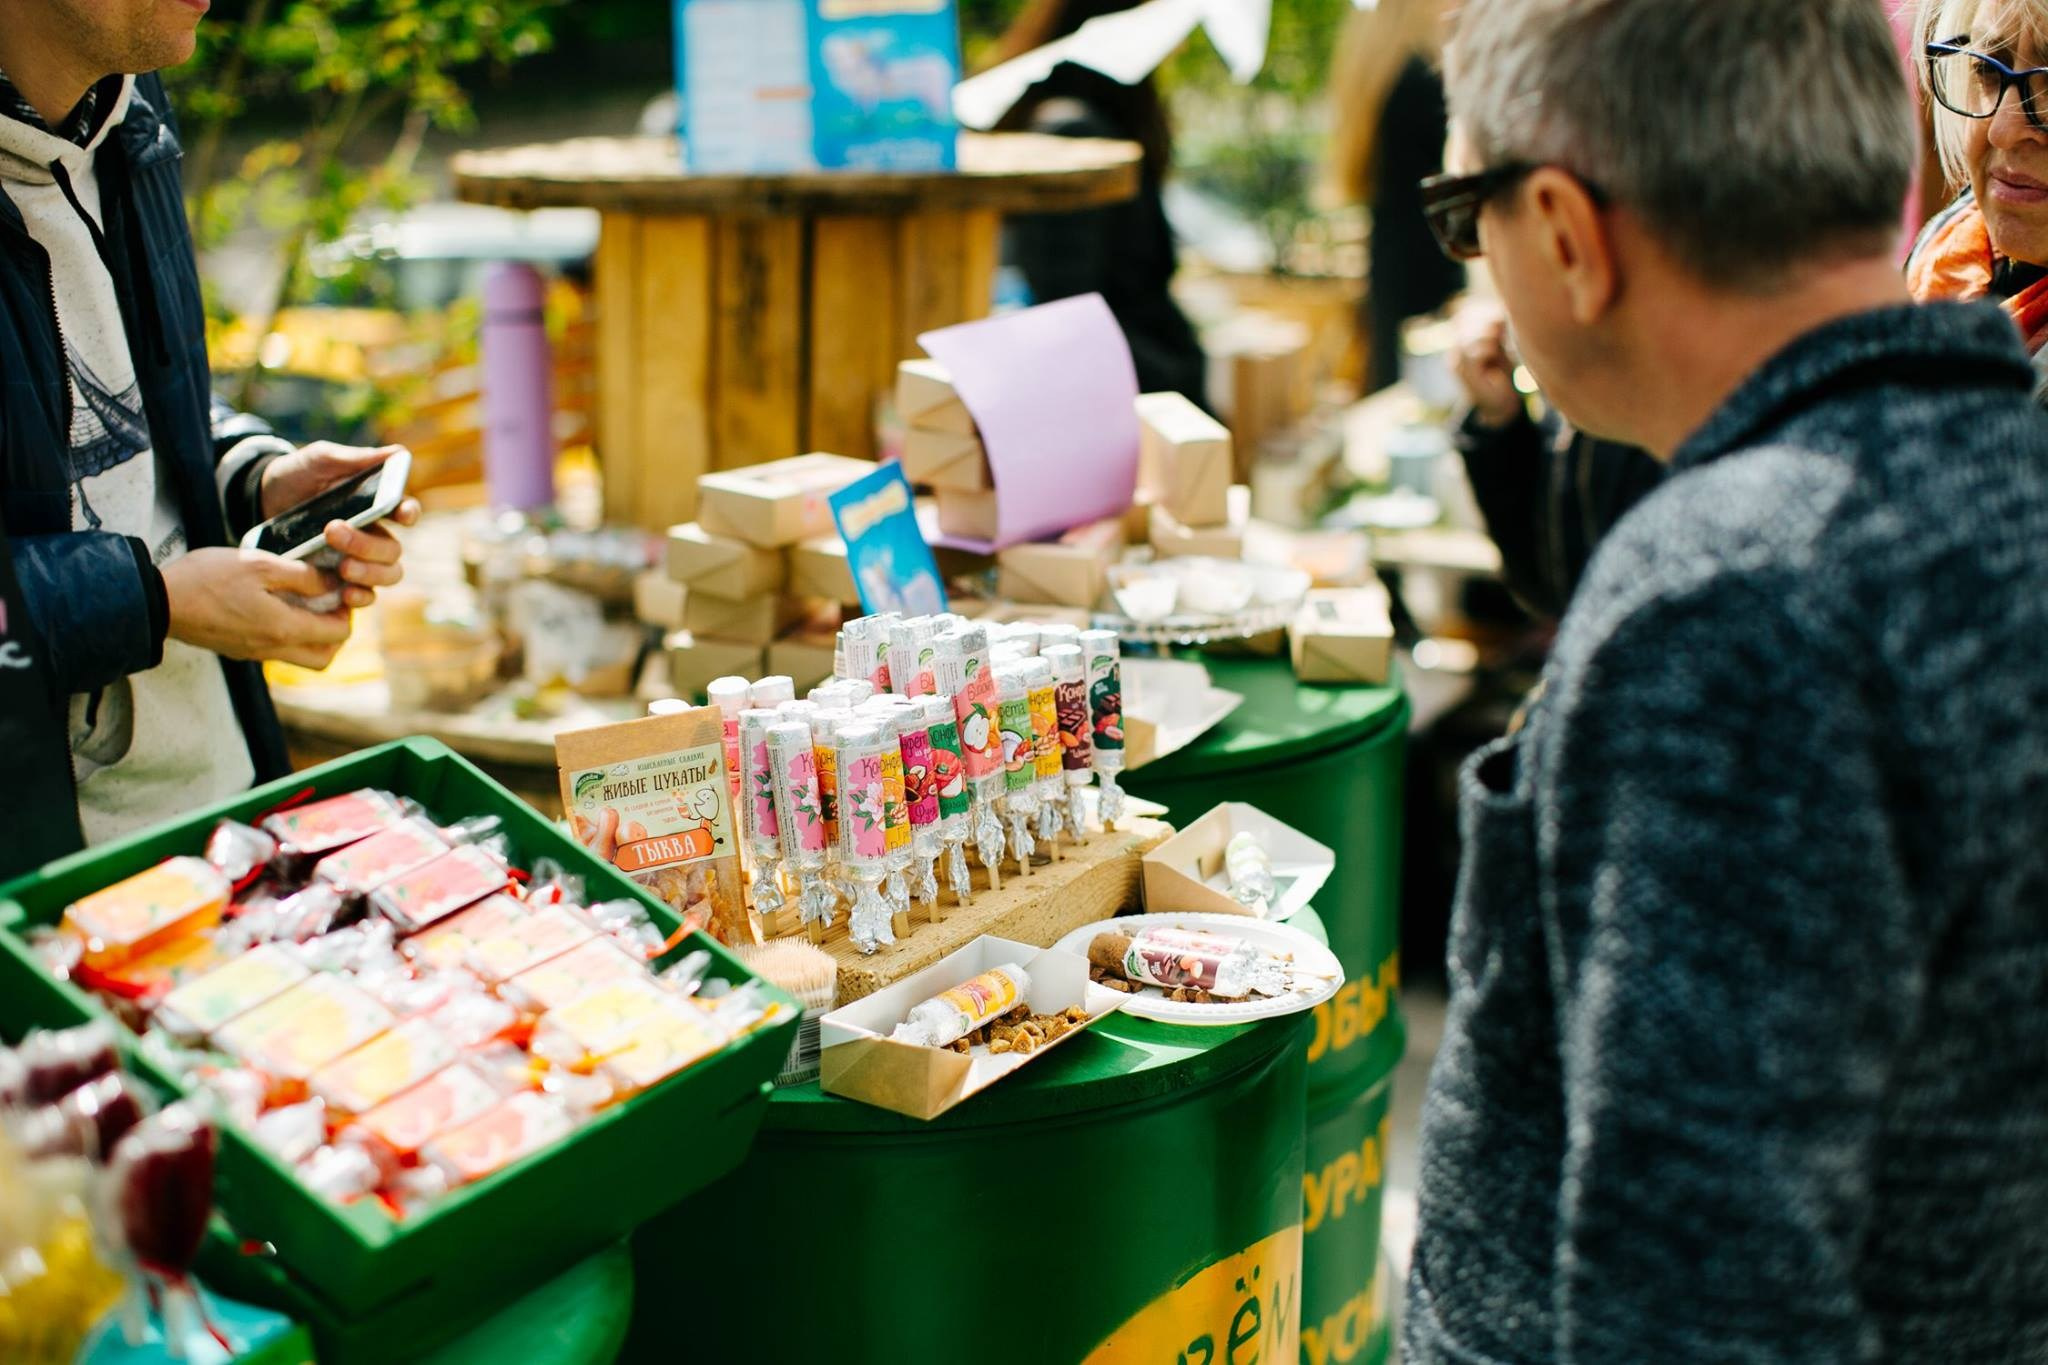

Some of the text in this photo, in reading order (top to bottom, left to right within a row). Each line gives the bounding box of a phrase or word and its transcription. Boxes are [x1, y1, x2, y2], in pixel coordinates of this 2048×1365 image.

[602, 777, 648, 801] ЖИВЫЕ
[653, 765, 707, 791] ЦУКАТЫ
[631, 834, 697, 865] ТЫКВА
